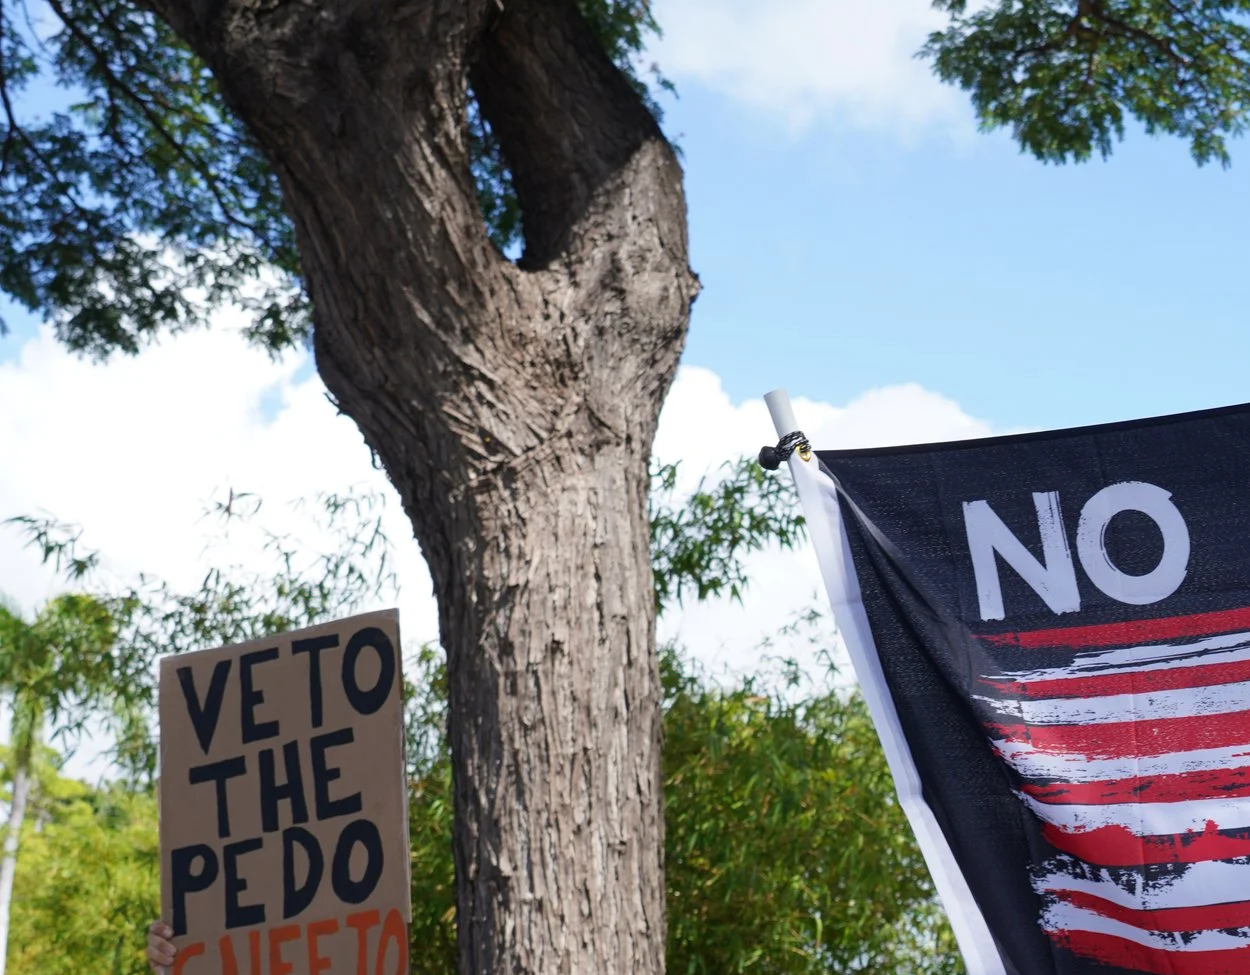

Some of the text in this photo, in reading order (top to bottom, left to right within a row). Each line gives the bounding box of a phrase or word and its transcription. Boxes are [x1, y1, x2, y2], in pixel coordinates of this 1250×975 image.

[962, 481, 1190, 621] NO
[176, 626, 396, 755] VETO
[189, 727, 362, 838] THE
[171, 819, 384, 936] PEDO
